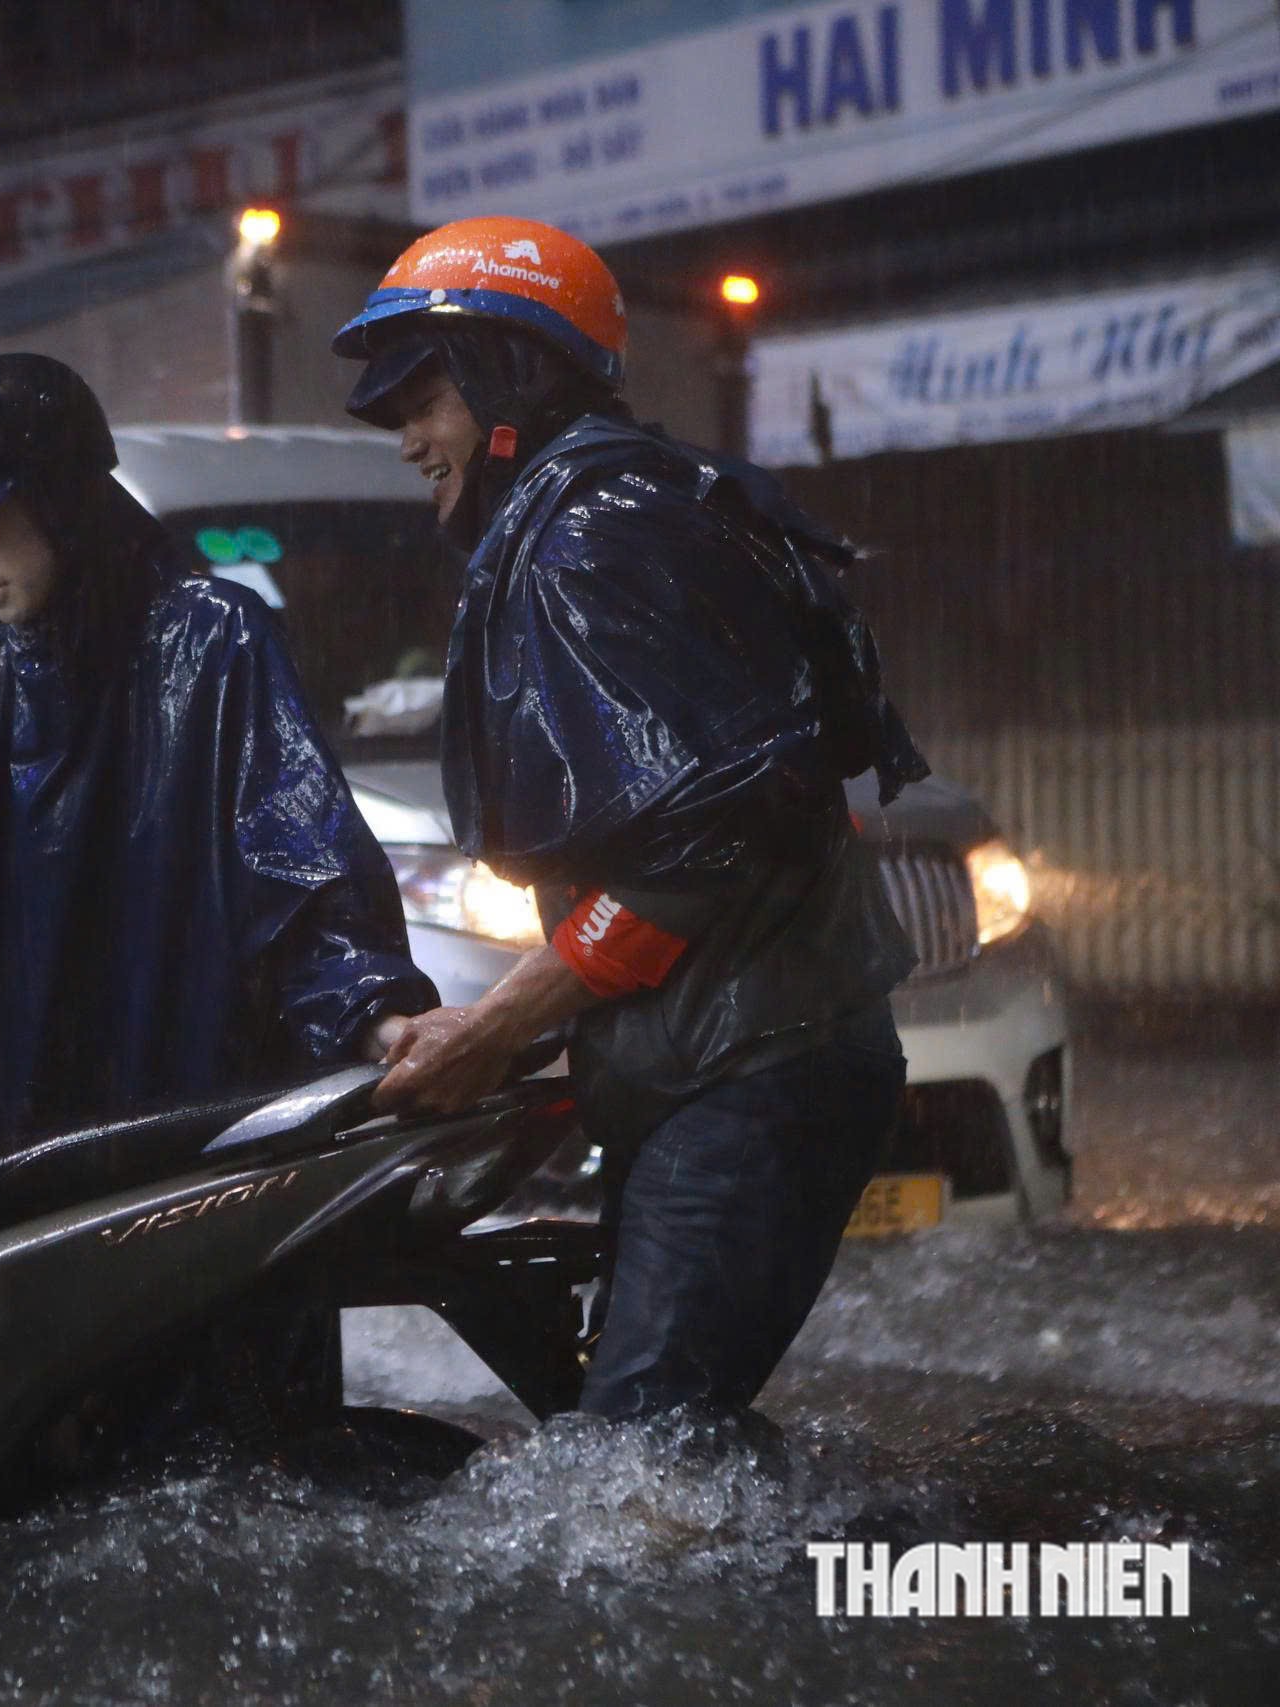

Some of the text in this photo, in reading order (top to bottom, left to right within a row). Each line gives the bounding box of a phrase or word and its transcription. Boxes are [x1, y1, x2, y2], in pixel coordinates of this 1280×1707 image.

[760, 5, 900, 137] HAI
[471, 257, 561, 290] Ahamove
[100, 1168, 302, 1245] VISION
